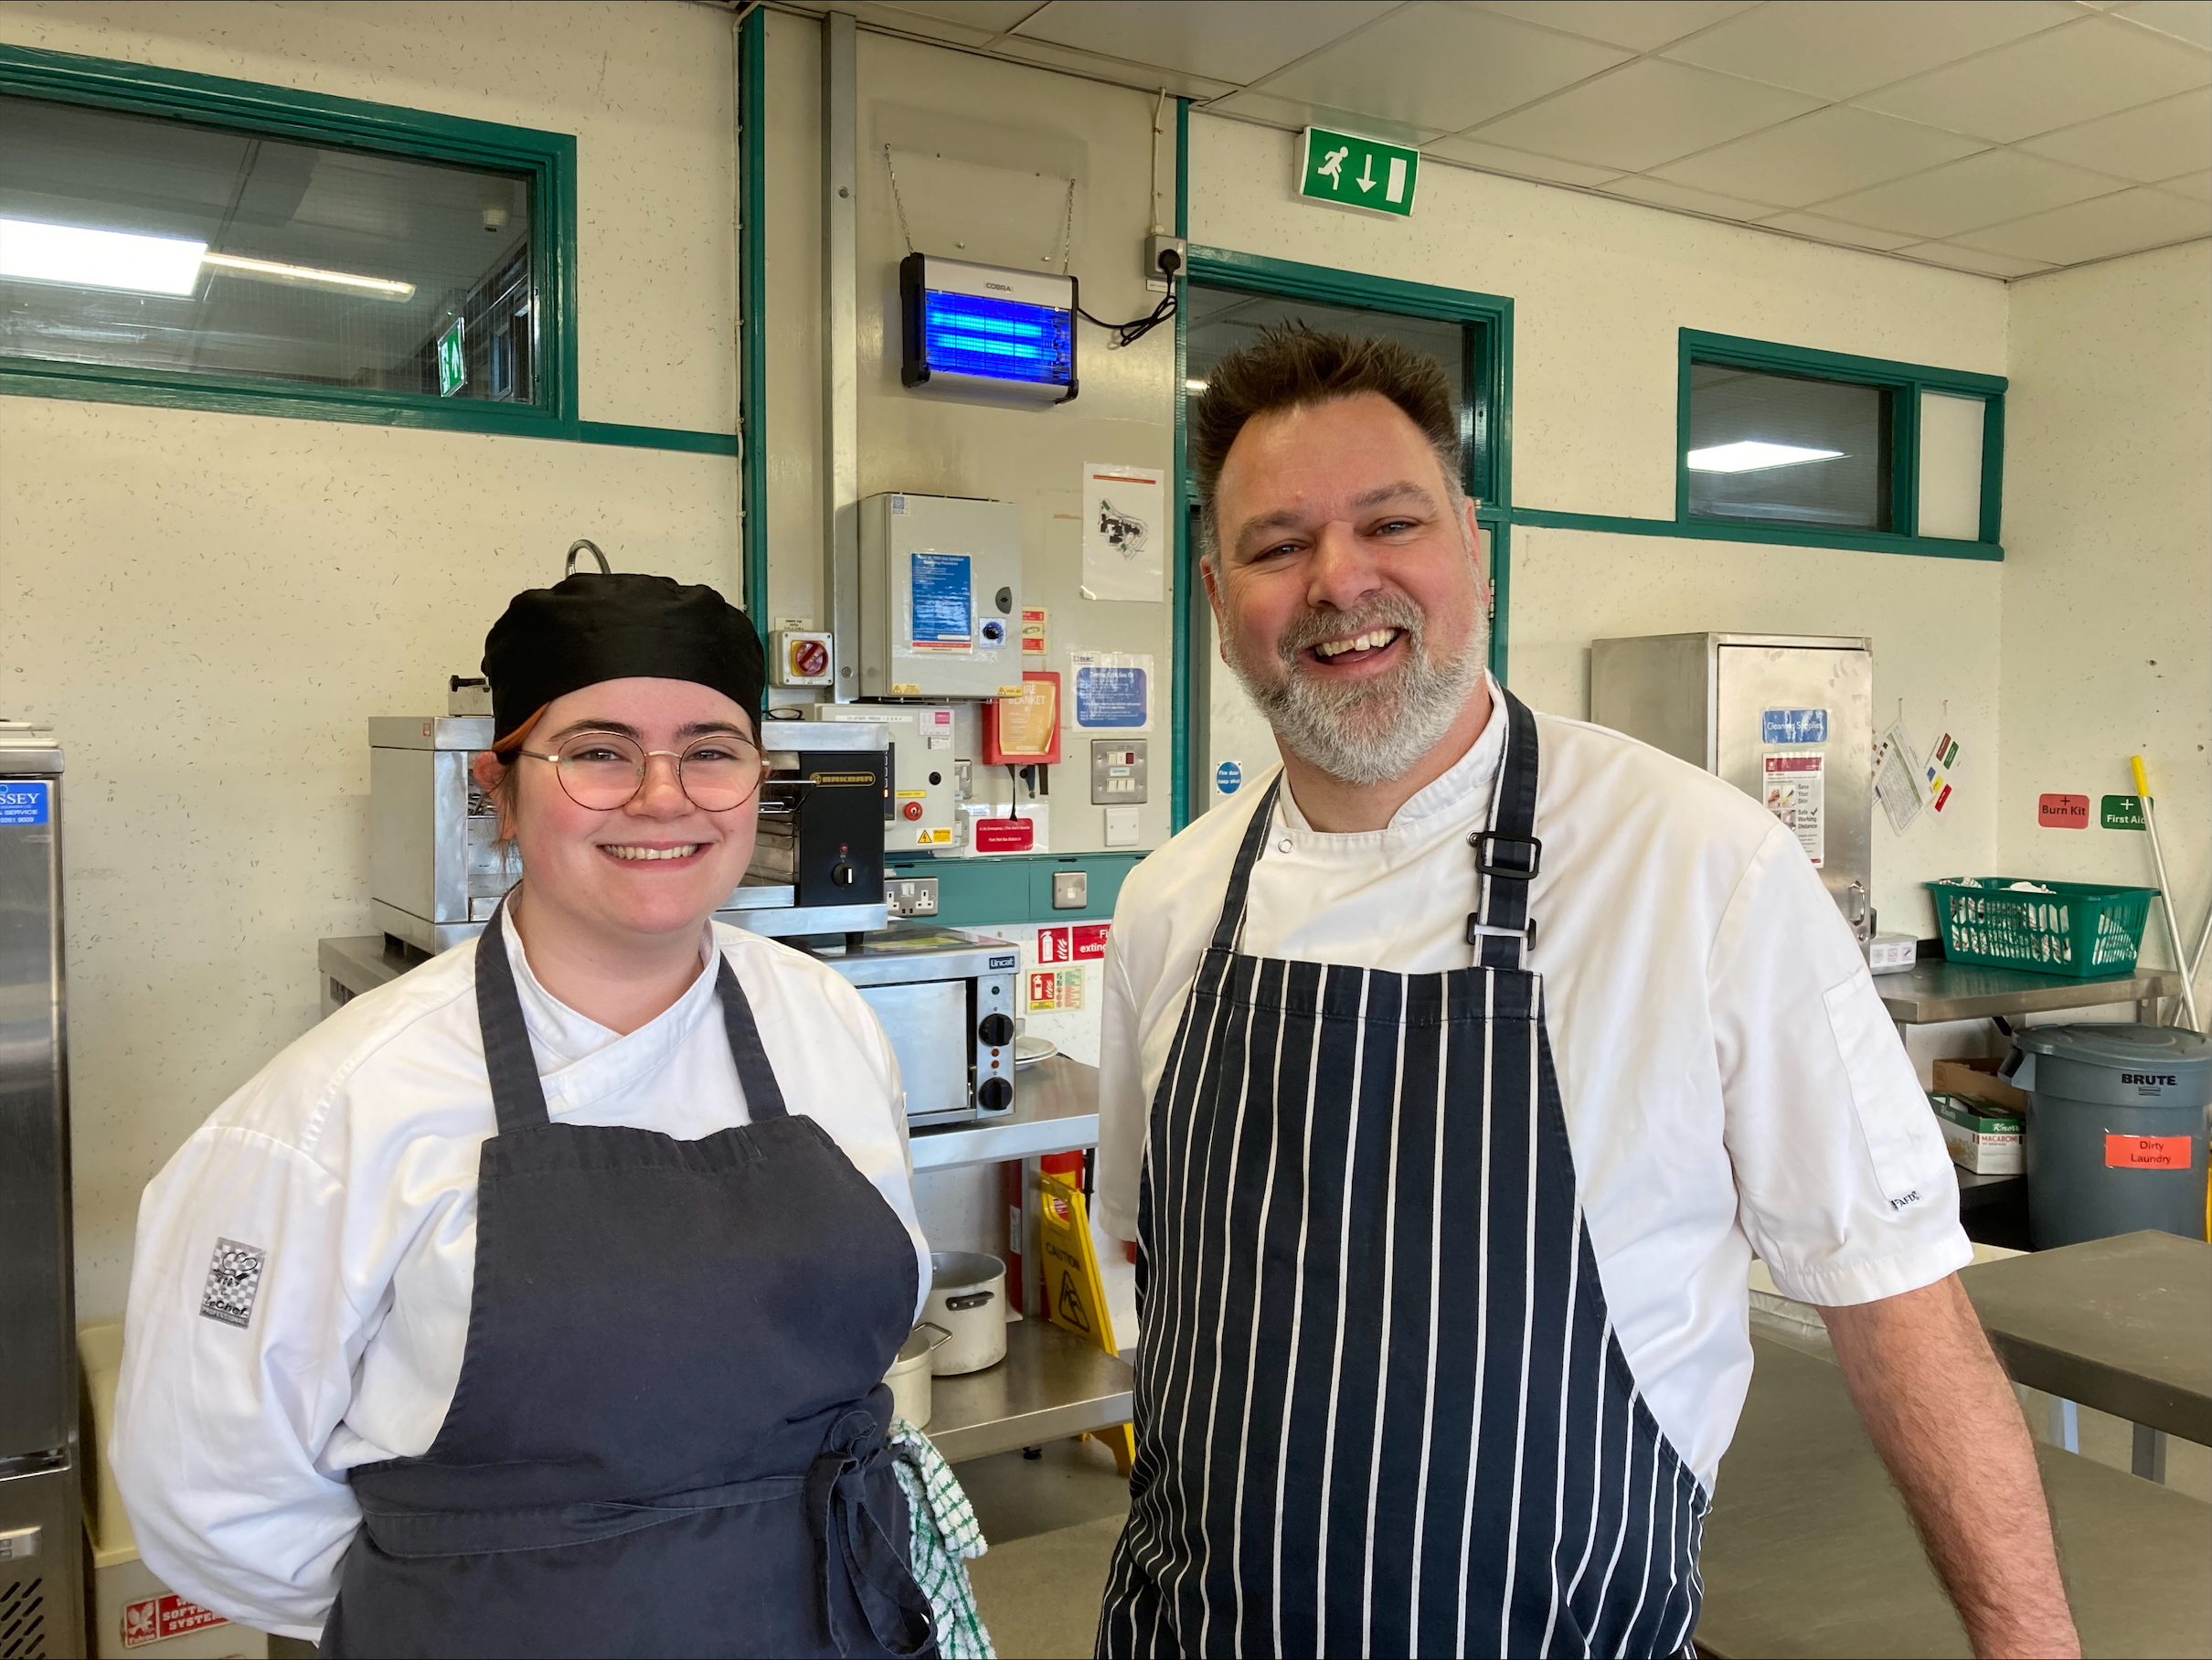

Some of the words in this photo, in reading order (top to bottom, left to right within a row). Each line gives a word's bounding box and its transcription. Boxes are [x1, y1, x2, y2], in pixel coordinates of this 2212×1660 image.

[985, 282, 1012, 293] COBRA
[1024, 685, 1037, 694] IRE
[1768, 722, 1794, 731] Cleaning
[1796, 721, 1823, 731] Supplies
[0, 793, 40, 804] SSEY
[2042, 805, 2068, 814] Burn
[2071, 806, 2086, 815] Kit
[2107, 814, 2128, 823] First
[1100, 930, 1108, 938] Fi
[991, 958, 1013, 967] Lincat
[2122, 1074, 2176, 1086] BRUTE
[1993, 1123, 2020, 1132] Knorr
[2140, 1141, 2164, 1152] Dirty
[2132, 1154, 2171, 1165] Laundry
[1046, 1242, 1080, 1271] CAUTION
[203, 1306, 247, 1325] PROFESSIONAL
[163, 1605, 207, 1622] SOFTE
[168, 1612, 222, 1631] SYSTE
[129, 1633, 155, 1644] Falcon
